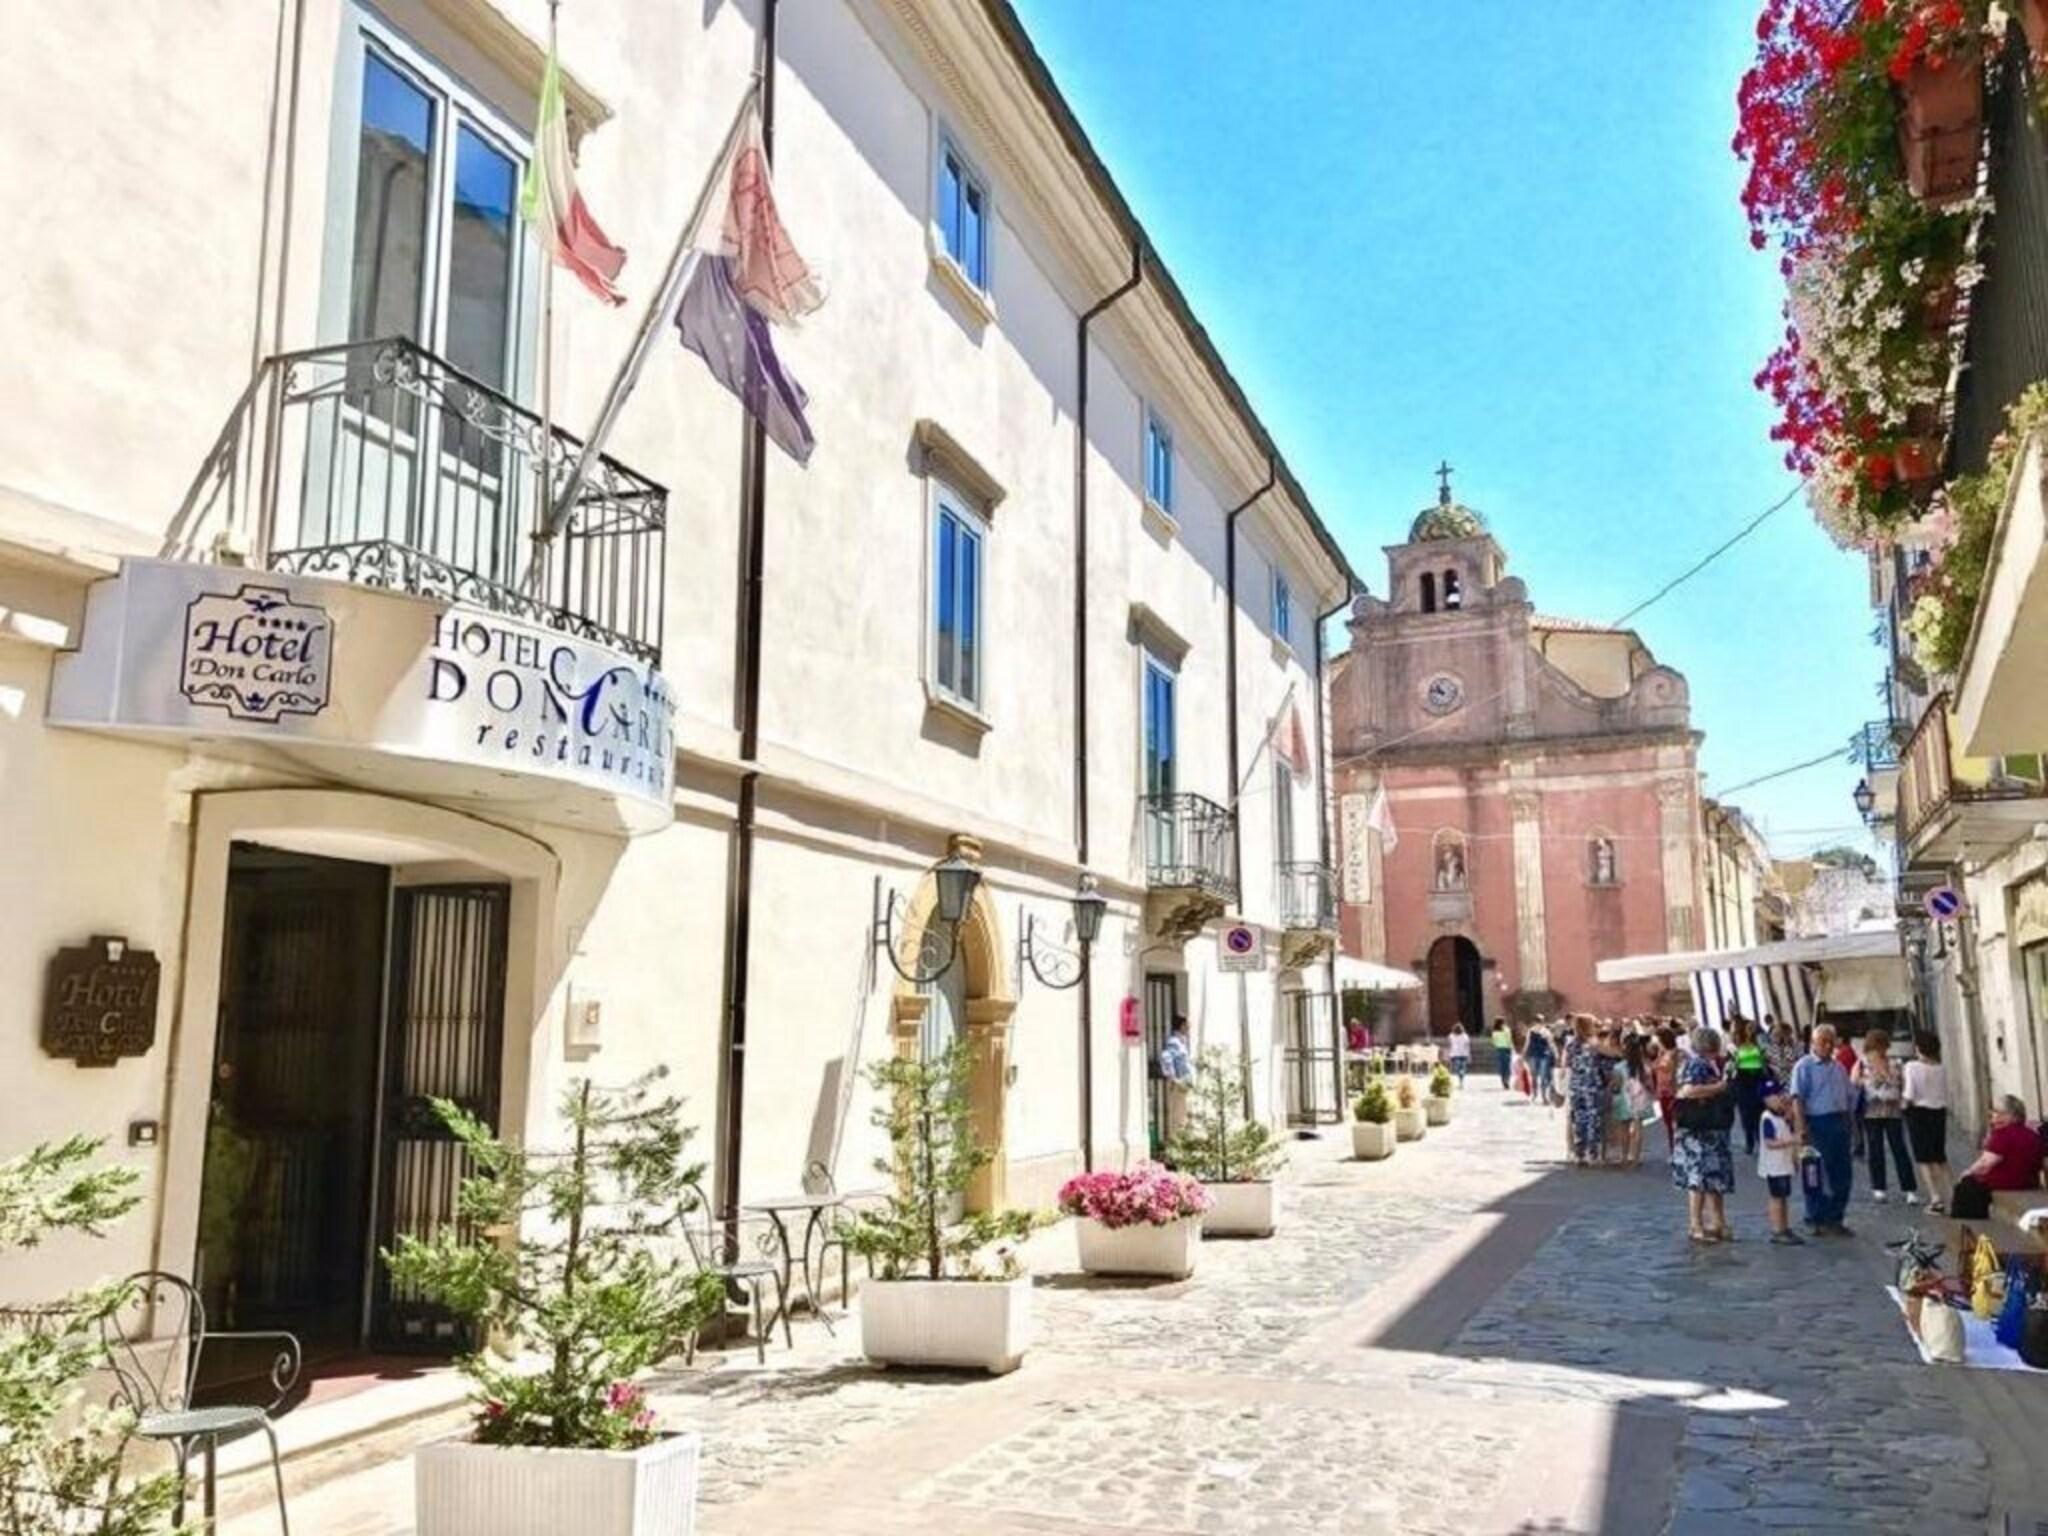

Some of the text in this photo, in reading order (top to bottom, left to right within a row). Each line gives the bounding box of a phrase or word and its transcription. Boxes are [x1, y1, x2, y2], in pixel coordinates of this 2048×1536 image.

[194, 615, 325, 662] Hotel
[433, 614, 546, 671] HOTEL
[190, 658, 316, 686] Don Carlo
[427, 656, 568, 724] DON
[61, 967, 153, 1007] Hotel
